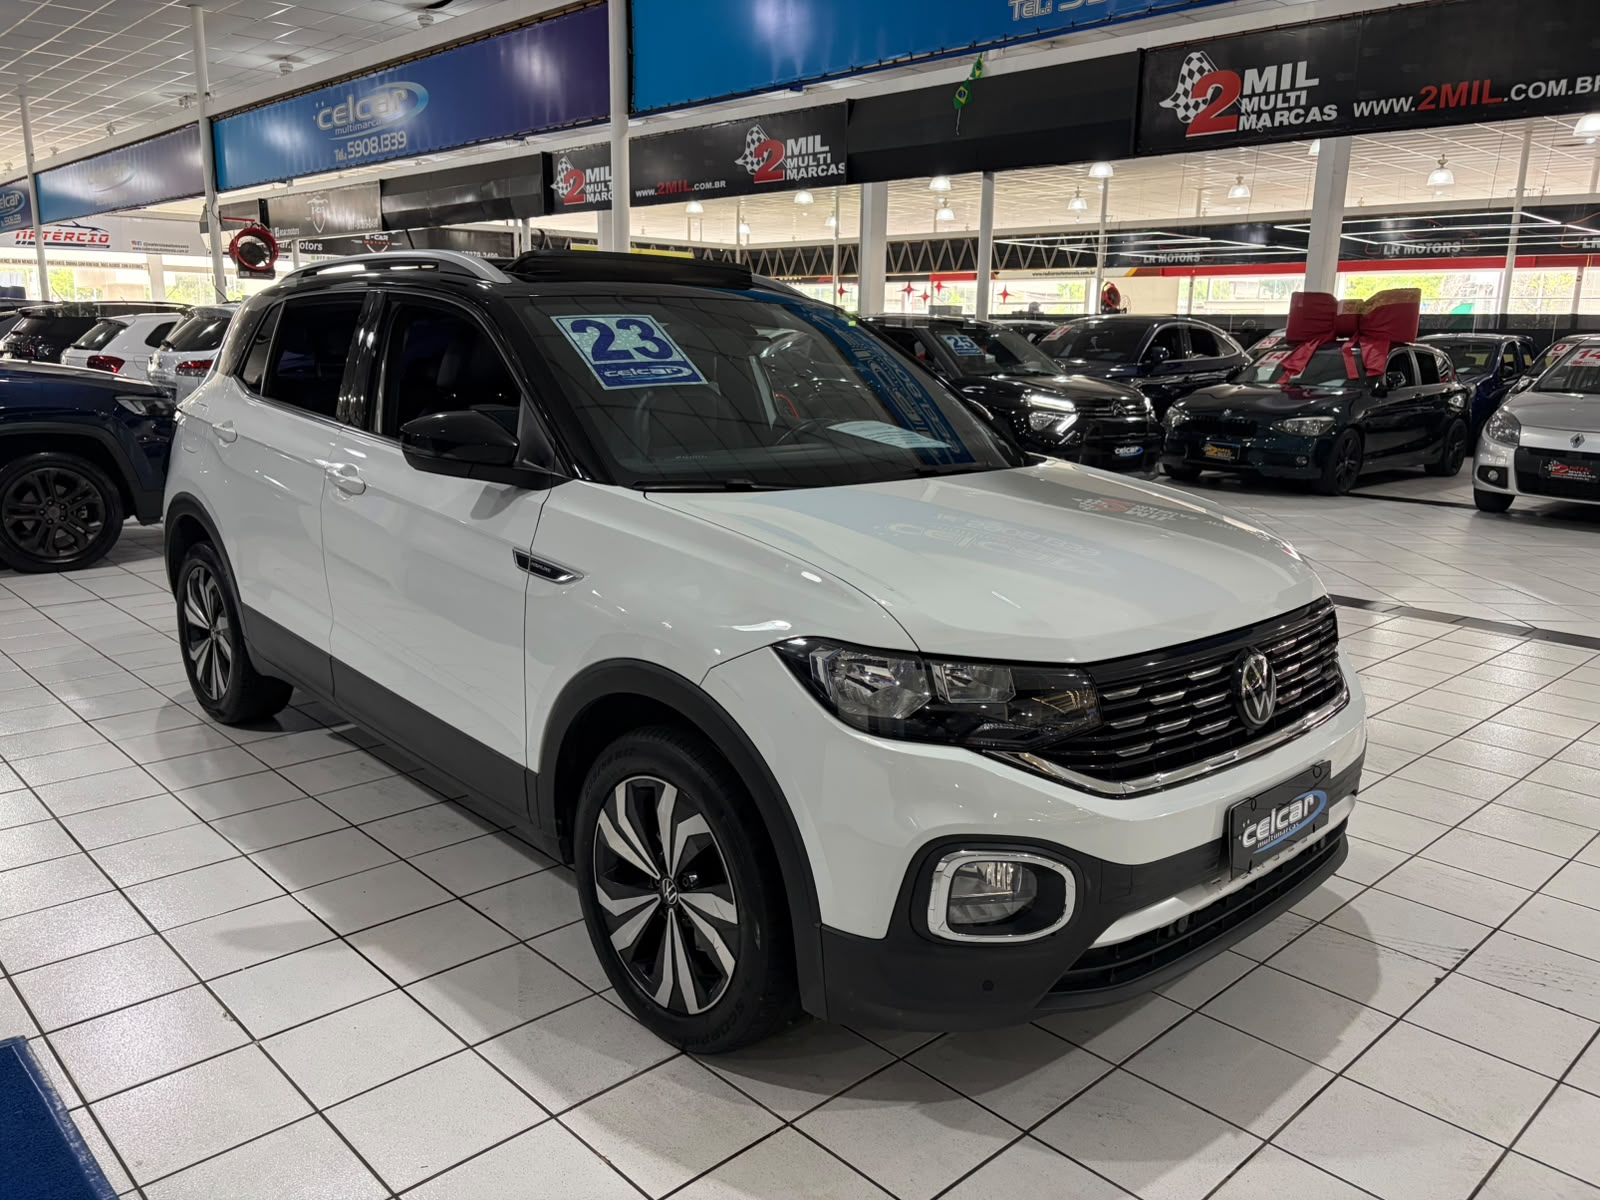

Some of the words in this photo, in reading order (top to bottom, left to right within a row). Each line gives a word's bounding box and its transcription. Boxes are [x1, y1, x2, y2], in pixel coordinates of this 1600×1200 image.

[1243, 60, 1320, 95] MIL
[317, 88, 409, 130] celcar
[1241, 90, 1308, 113] MULTI
[1238, 104, 1338, 131] MARCAS
[347, 130, 407, 159] 5908.1339
[786, 134, 830, 156] MIL
[786, 153, 831, 168] MULTI
[786, 162, 845, 181] MARCAS
[585, 182, 613, 193] MULT
[586, 192, 613, 203] MARC
[570, 319, 674, 361] 23
[947, 336, 975, 349] 25
[1242, 793, 1315, 848] celcar
[1258, 823, 1300, 848] multimarcas
